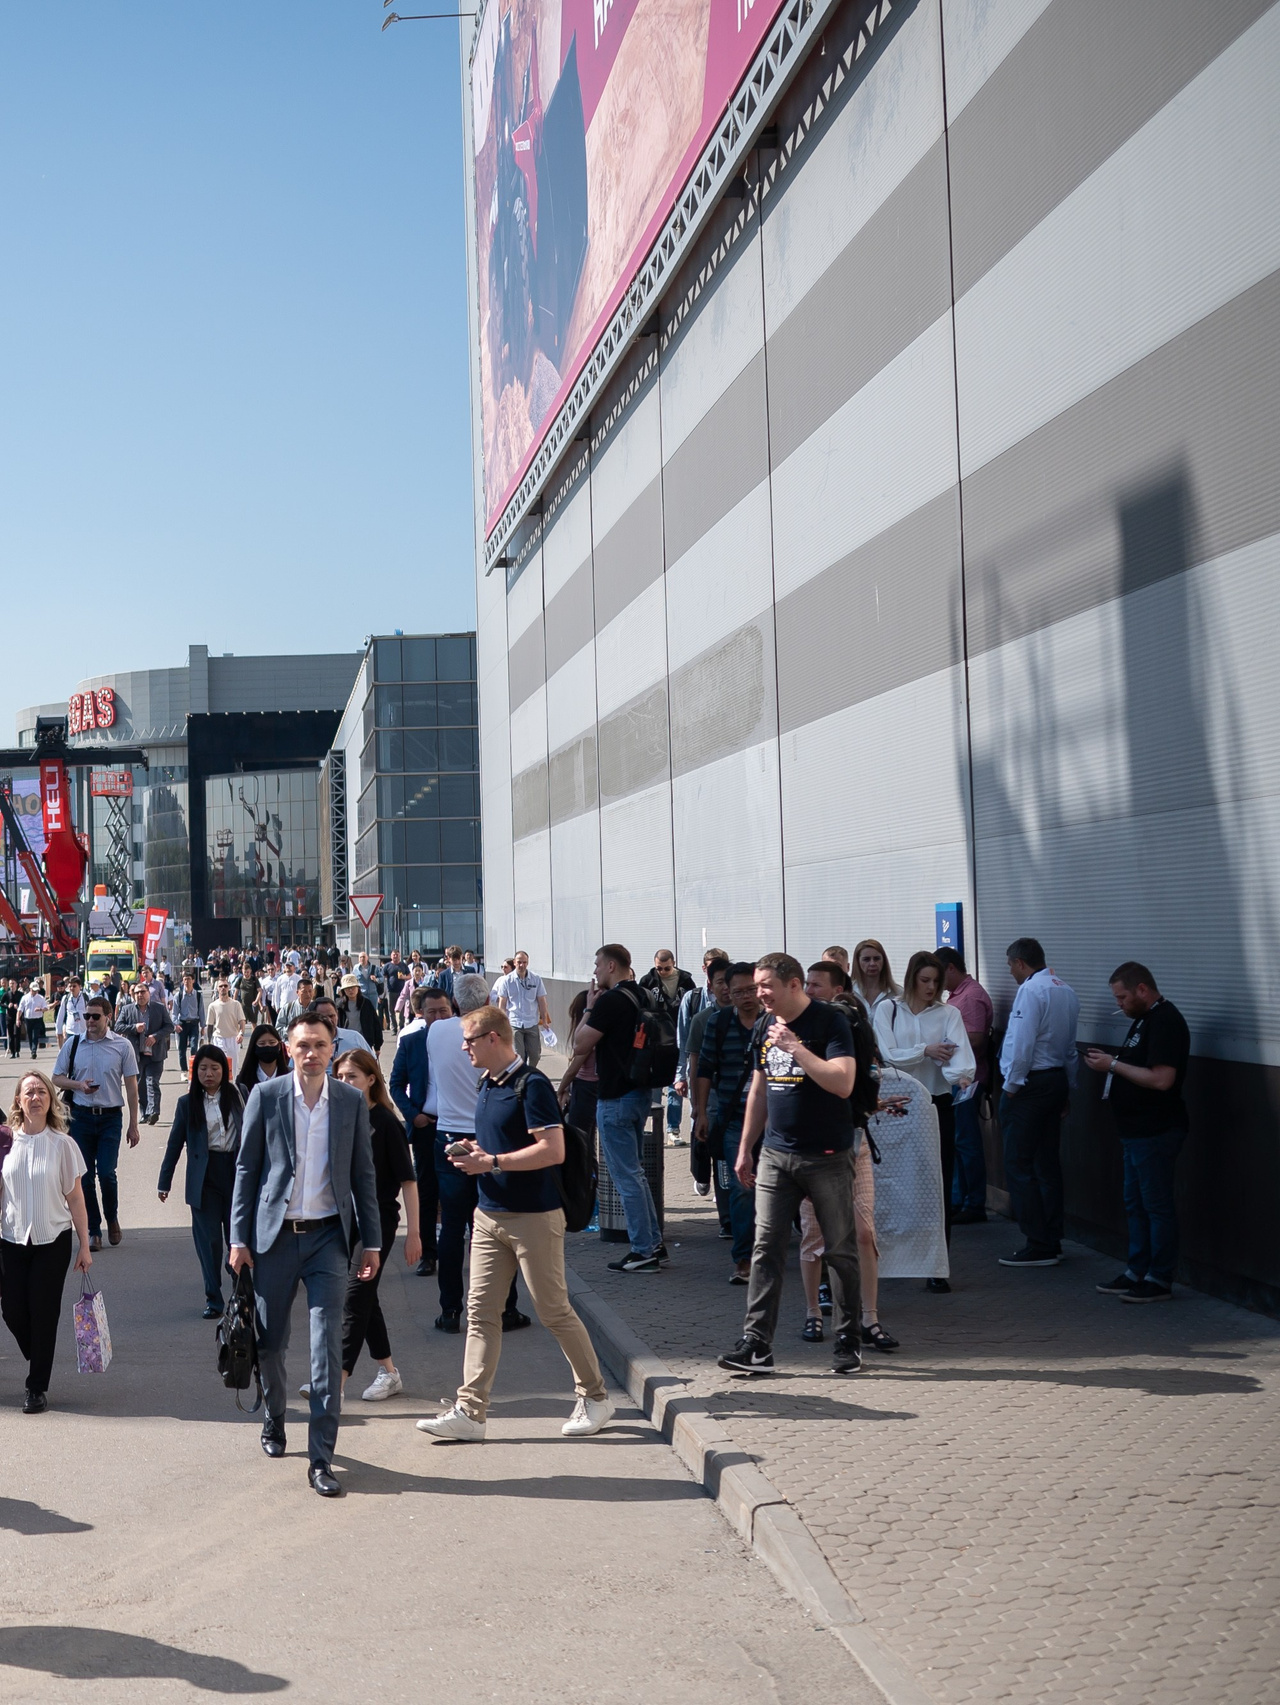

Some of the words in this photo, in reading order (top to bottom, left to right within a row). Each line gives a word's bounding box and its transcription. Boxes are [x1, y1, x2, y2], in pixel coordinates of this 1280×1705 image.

[69, 687, 117, 736] GAS
[45, 766, 62, 830] HELI
[144, 914, 164, 966] ELI
